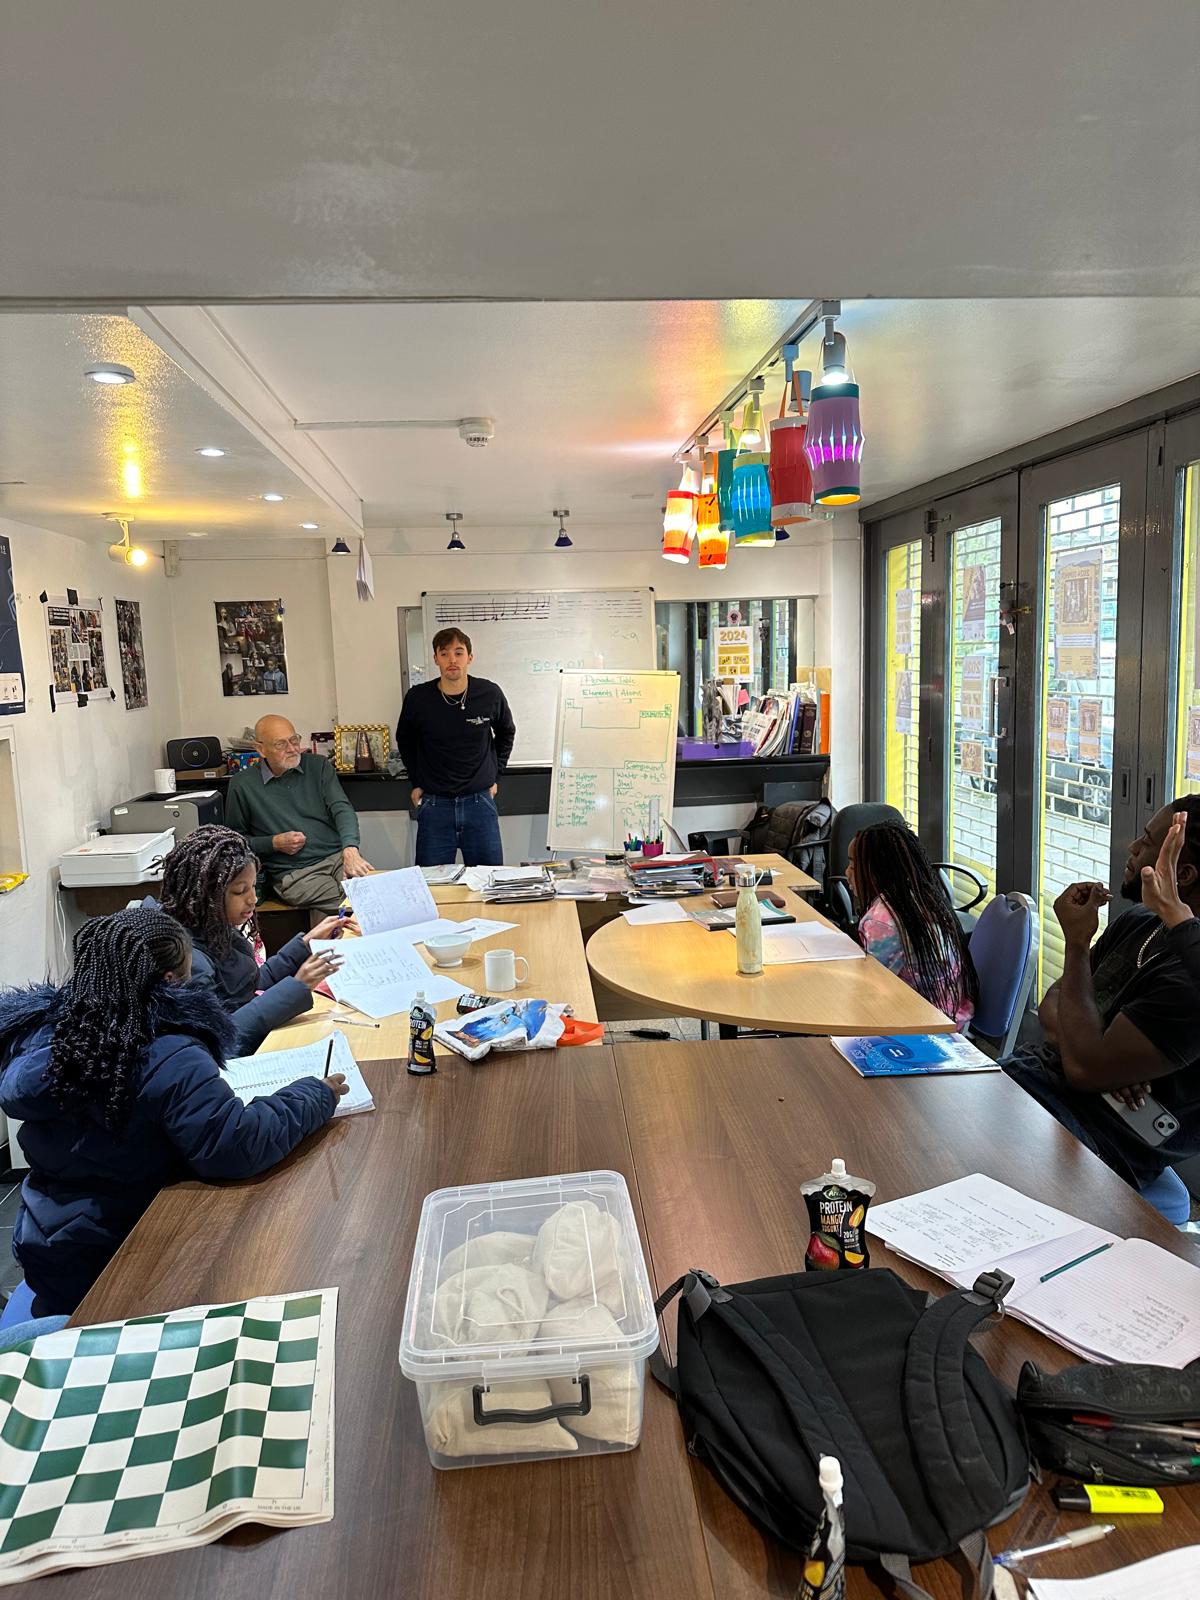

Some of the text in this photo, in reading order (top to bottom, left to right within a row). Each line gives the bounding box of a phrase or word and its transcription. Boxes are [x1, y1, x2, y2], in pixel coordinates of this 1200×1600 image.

[720, 630, 748, 641] 2024
[819, 1201, 853, 1215] PROTEIN
[820, 1214, 843, 1225] MANGO
